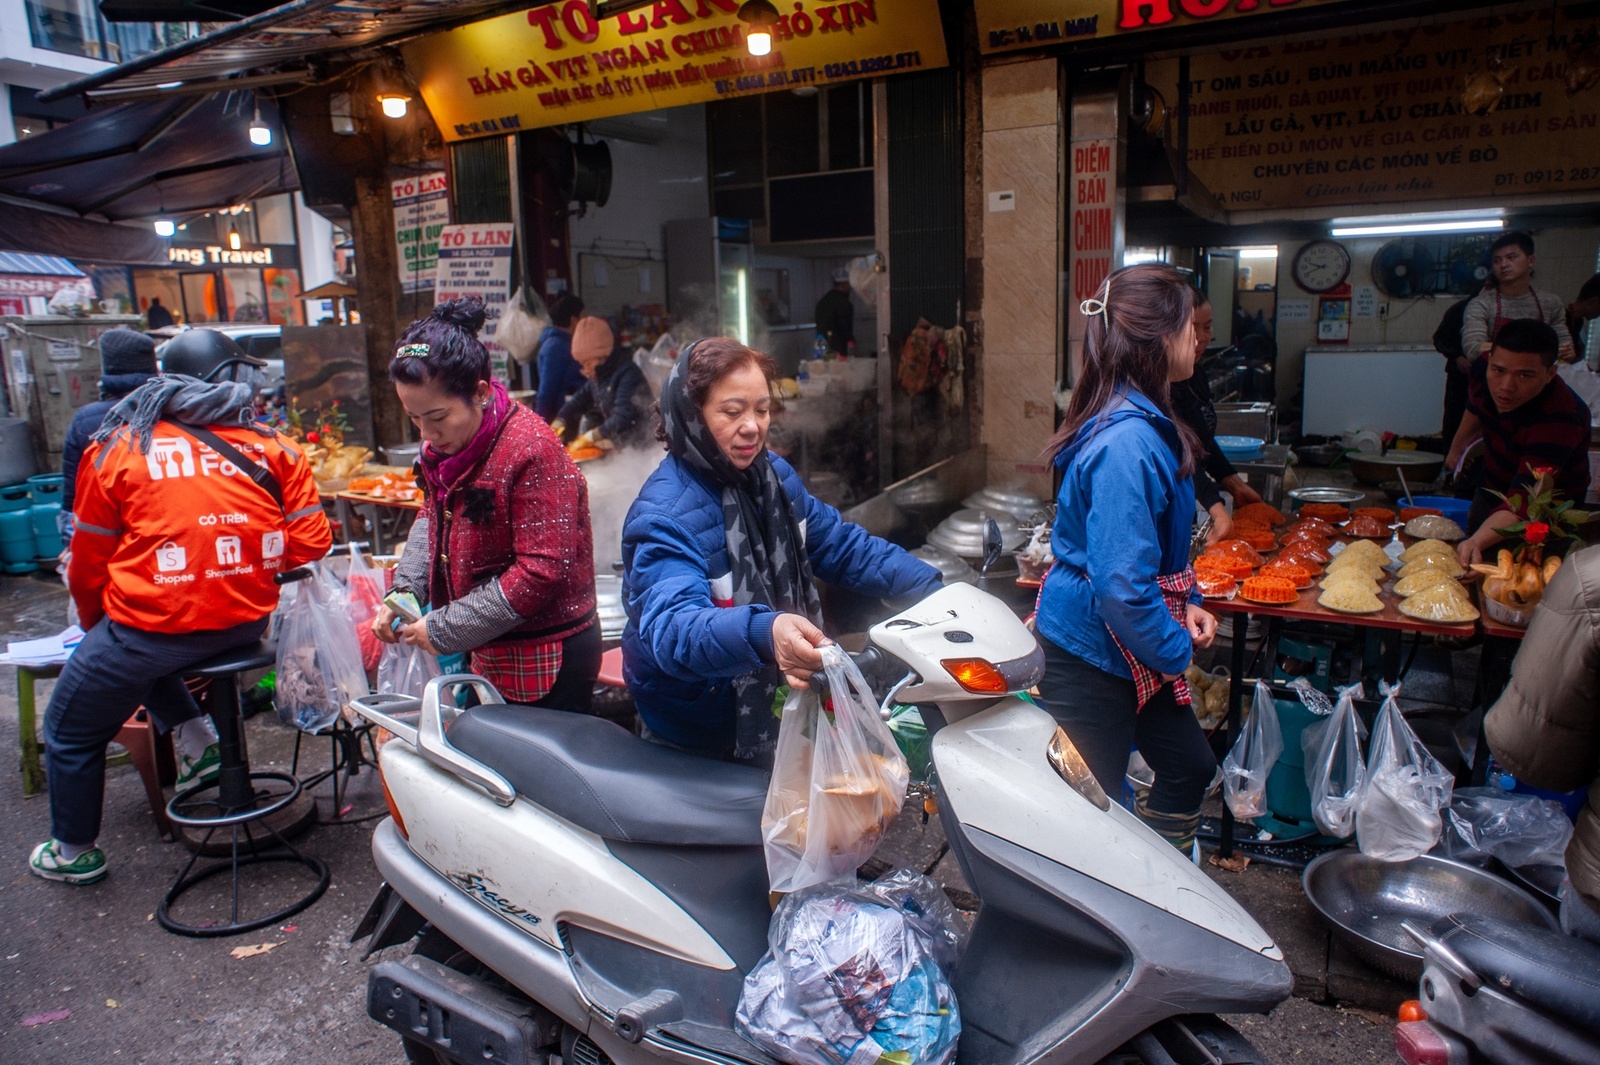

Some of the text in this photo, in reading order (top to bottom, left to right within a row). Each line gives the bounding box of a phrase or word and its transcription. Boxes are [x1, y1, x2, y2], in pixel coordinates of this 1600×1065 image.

[467, 67, 518, 96] BÁN
[517, 59, 551, 87] GÀ
[546, 55, 589, 81] VỊT
[592, 38, 672, 74] NGAN
[671, 24, 744, 58] CHIM
[815, 0, 879, 34] XỊN
[1211, 75, 1241, 93] OM
[1409, 100, 1463, 119] CHÁ
[1496, 92, 1542, 110] HIM
[1381, 130, 1415, 146] GIA
[1478, 123, 1494, 138] &
[1075, 139, 1110, 174] ĐIỂM
[1254, 158, 1329, 178] CHUYÊN
[1335, 155, 1375, 173] CÁC
[1382, 150, 1429, 169] MÓN
[1469, 145, 1498, 163] BÒ
[1524, 169, 1564, 184] 0912
[1078, 174, 1106, 204] BÁN
[471, 230, 512, 246] LAN
[1074, 208, 1111, 252] CHIM
[206, 245, 273, 264] Travel
[198, 512, 248, 526] CÓ TRÊN
[153, 573, 195, 586] Shopee
[205, 564, 254, 580] ShopeeFood
[523, 913, 542, 925] 125
